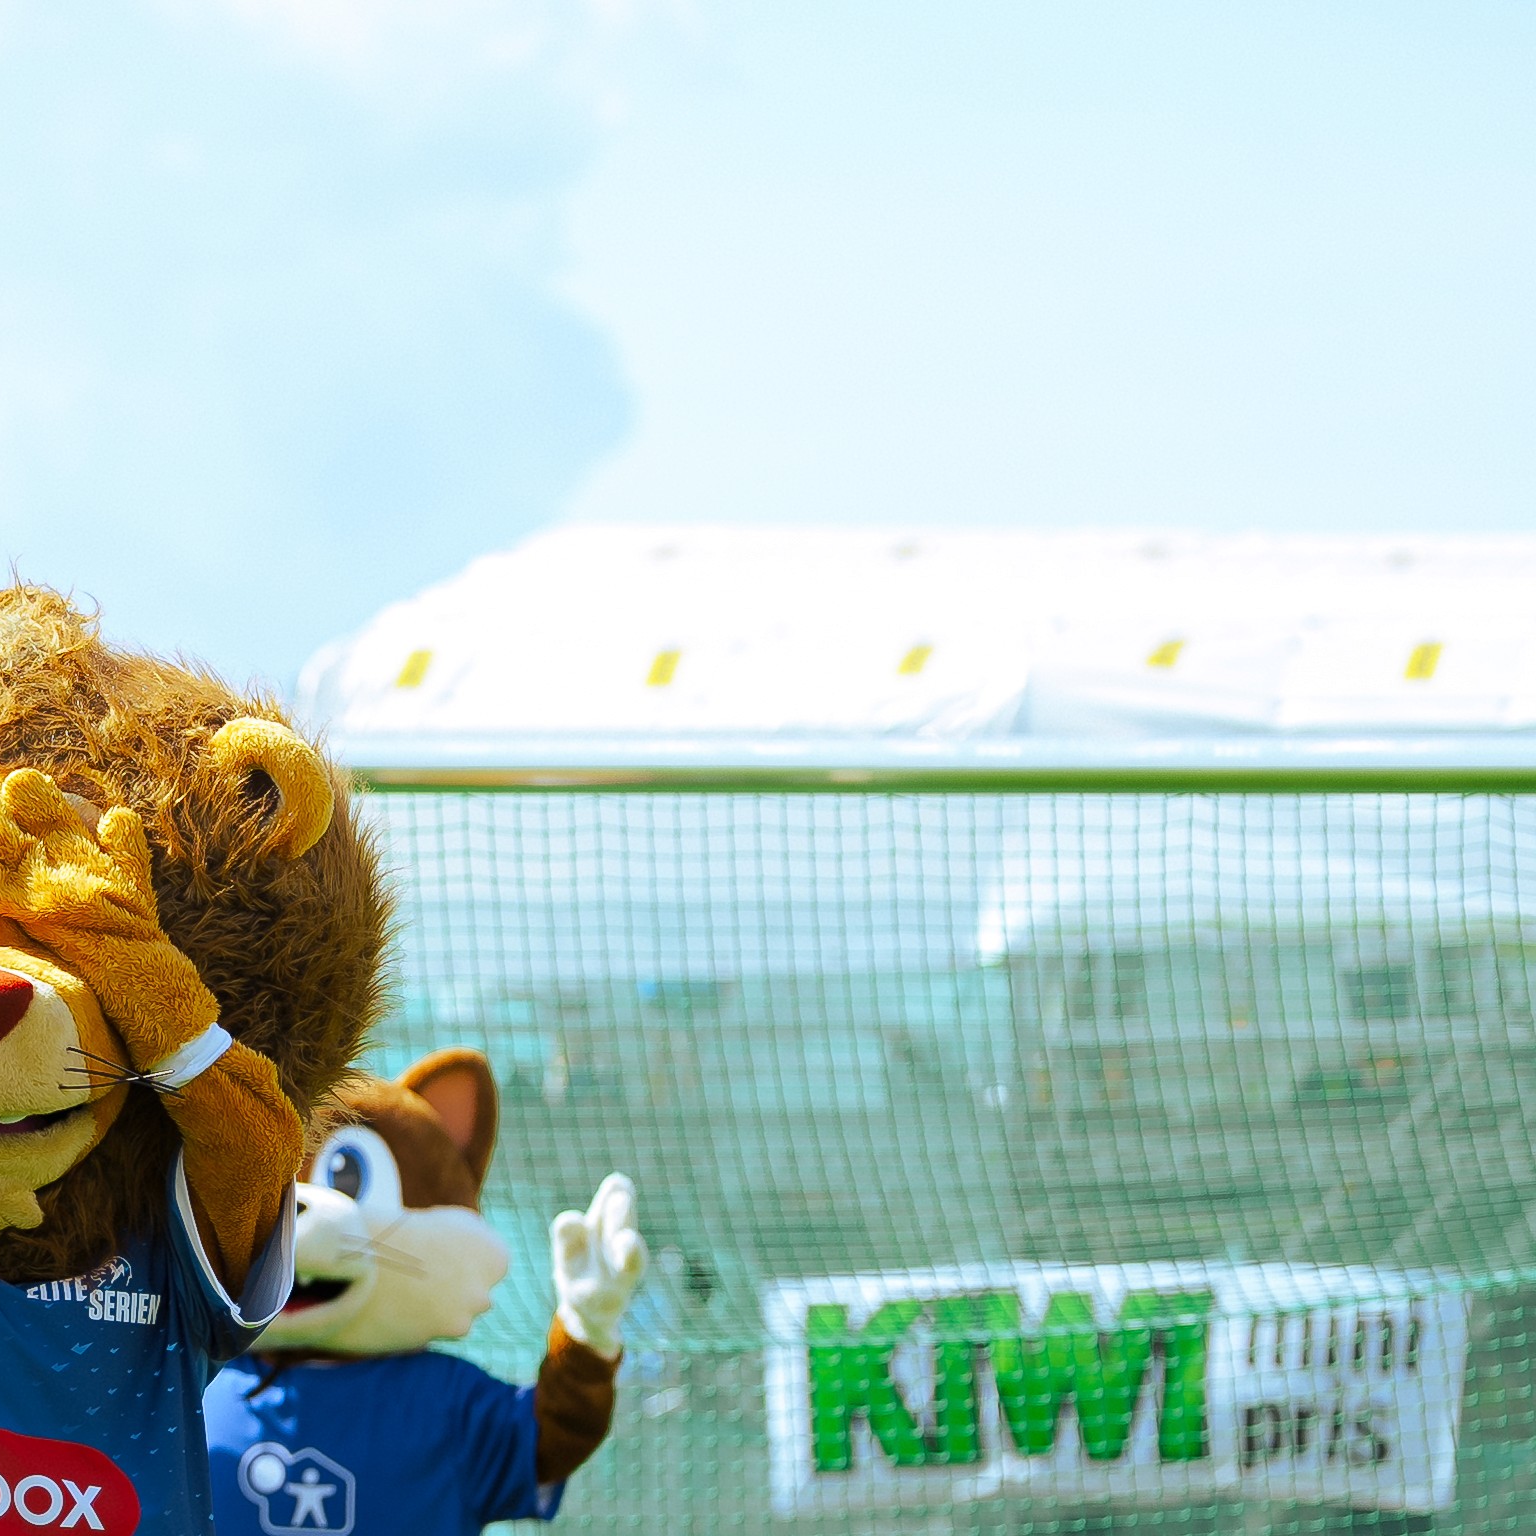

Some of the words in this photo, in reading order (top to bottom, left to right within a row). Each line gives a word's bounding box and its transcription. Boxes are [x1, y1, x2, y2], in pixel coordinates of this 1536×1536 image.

[88, 1289, 161, 1325] SERIEN
[805, 1287, 1216, 1474] KIWI
[1243, 1390, 1389, 1473] pris
